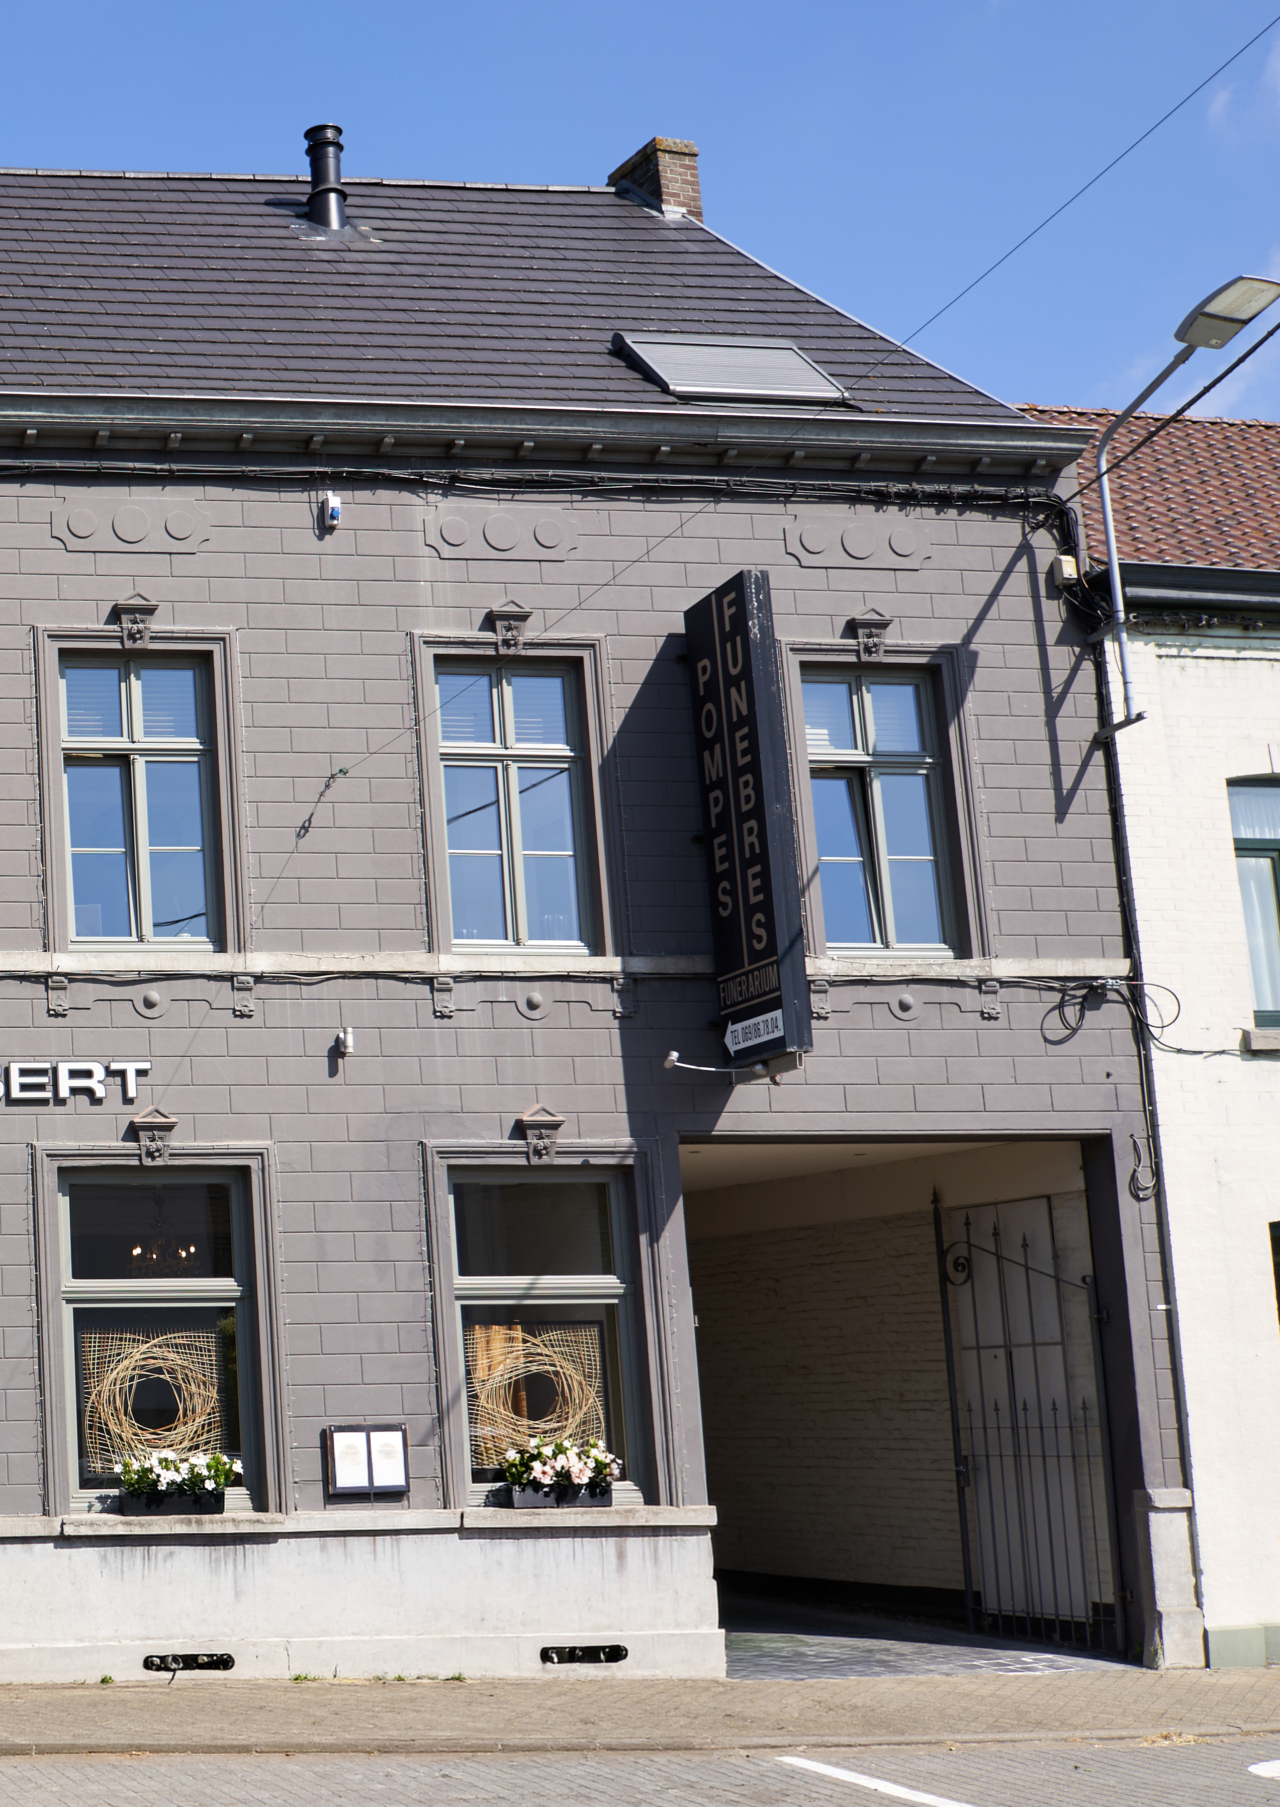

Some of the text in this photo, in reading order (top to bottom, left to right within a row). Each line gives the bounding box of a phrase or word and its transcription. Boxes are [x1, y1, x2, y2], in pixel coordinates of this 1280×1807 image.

[697, 658, 732, 917] POMPES
[723, 591, 767, 950] FUNEBRES
[720, 963, 779, 1007] FUNERARIUM
